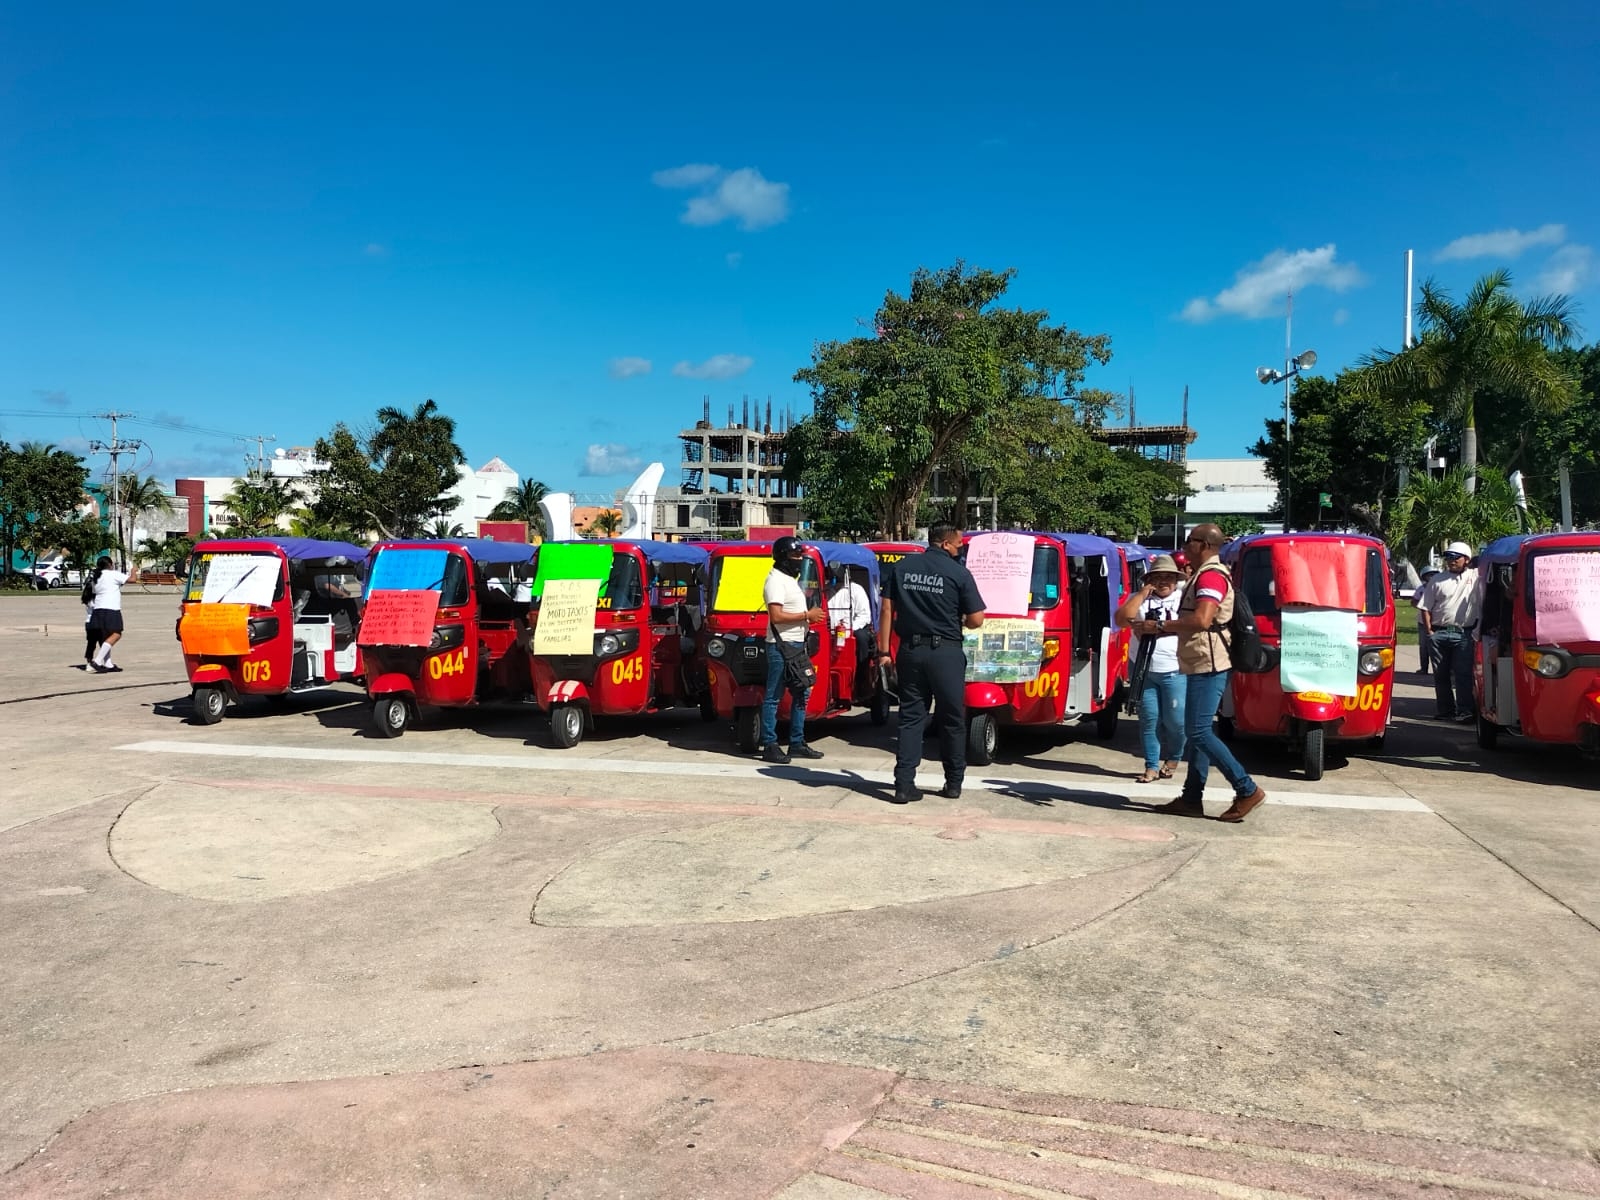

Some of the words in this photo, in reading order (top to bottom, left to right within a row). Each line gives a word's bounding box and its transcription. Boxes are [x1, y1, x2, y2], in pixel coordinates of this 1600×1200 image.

[882, 554, 906, 563] TAX
[902, 584, 931, 593] QUINTANA
[931, 587, 944, 595] ROO
[904, 572, 944, 587] POLICÍA
[597, 597, 612, 608] XI
[243, 660, 271, 683] 073
[430, 651, 464, 680] 044
[612, 656, 643, 685] 045
[1025, 672, 1059, 698] 002
[1345, 683, 1384, 711] 005
